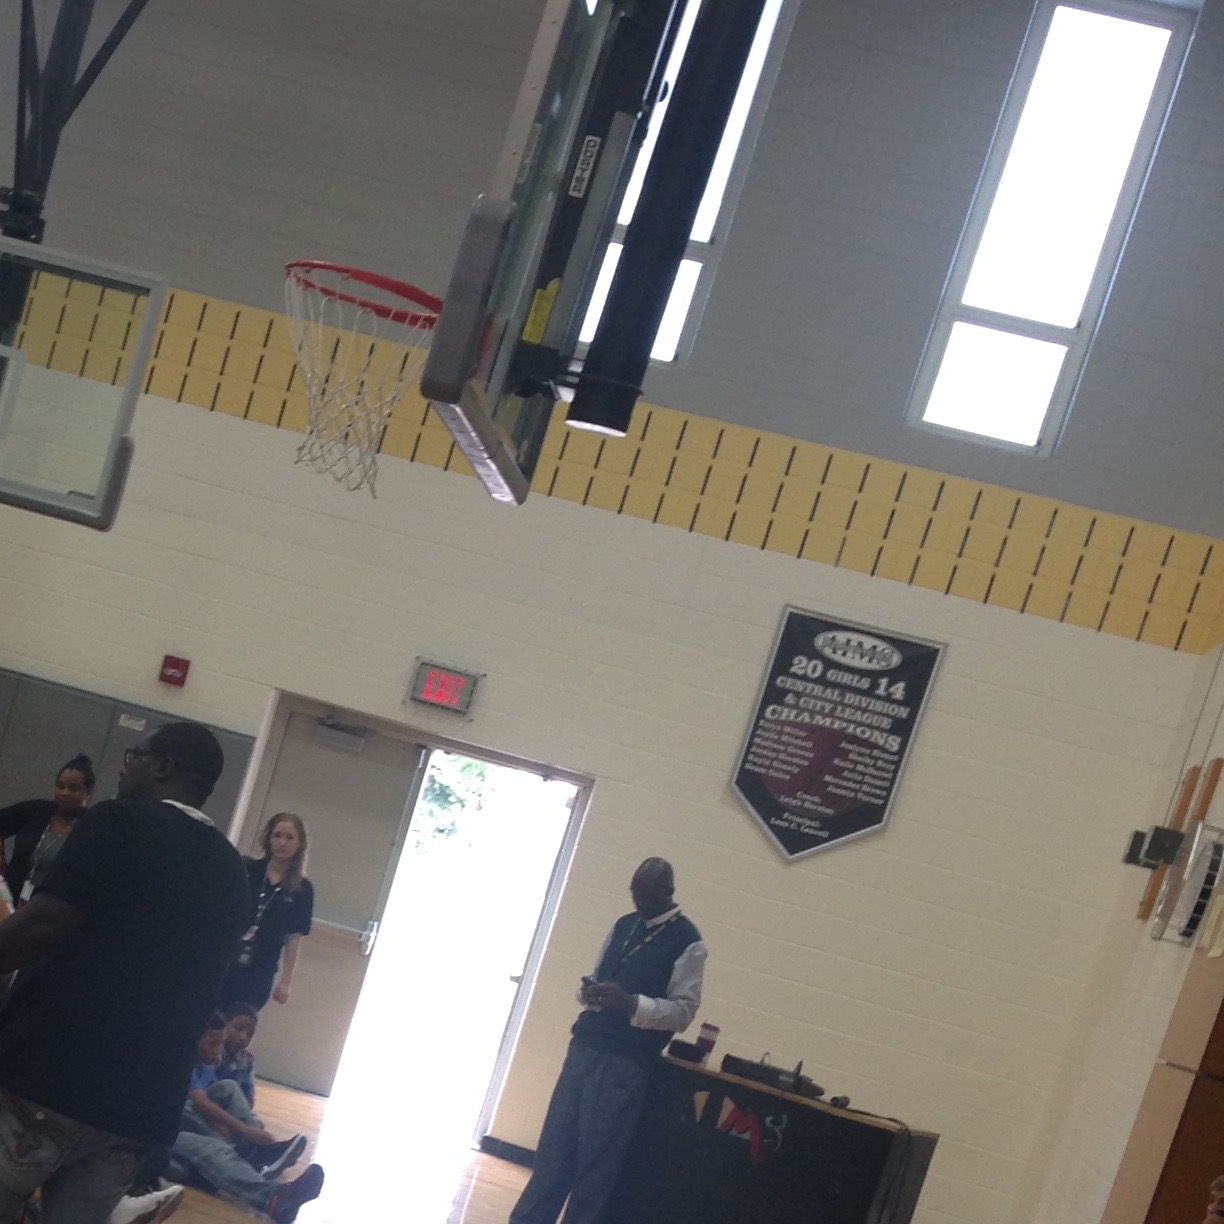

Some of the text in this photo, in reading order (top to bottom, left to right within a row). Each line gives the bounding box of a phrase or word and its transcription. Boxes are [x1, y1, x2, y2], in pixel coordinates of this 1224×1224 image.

[776, 676, 911, 719] CENTRAL DIVISION
[789, 655, 906, 700] 20 GIRLS 14
[764, 704, 902, 752] CHAMPIONS
[799, 697, 834, 715] CITY
[835, 704, 893, 729] LEAGUE
